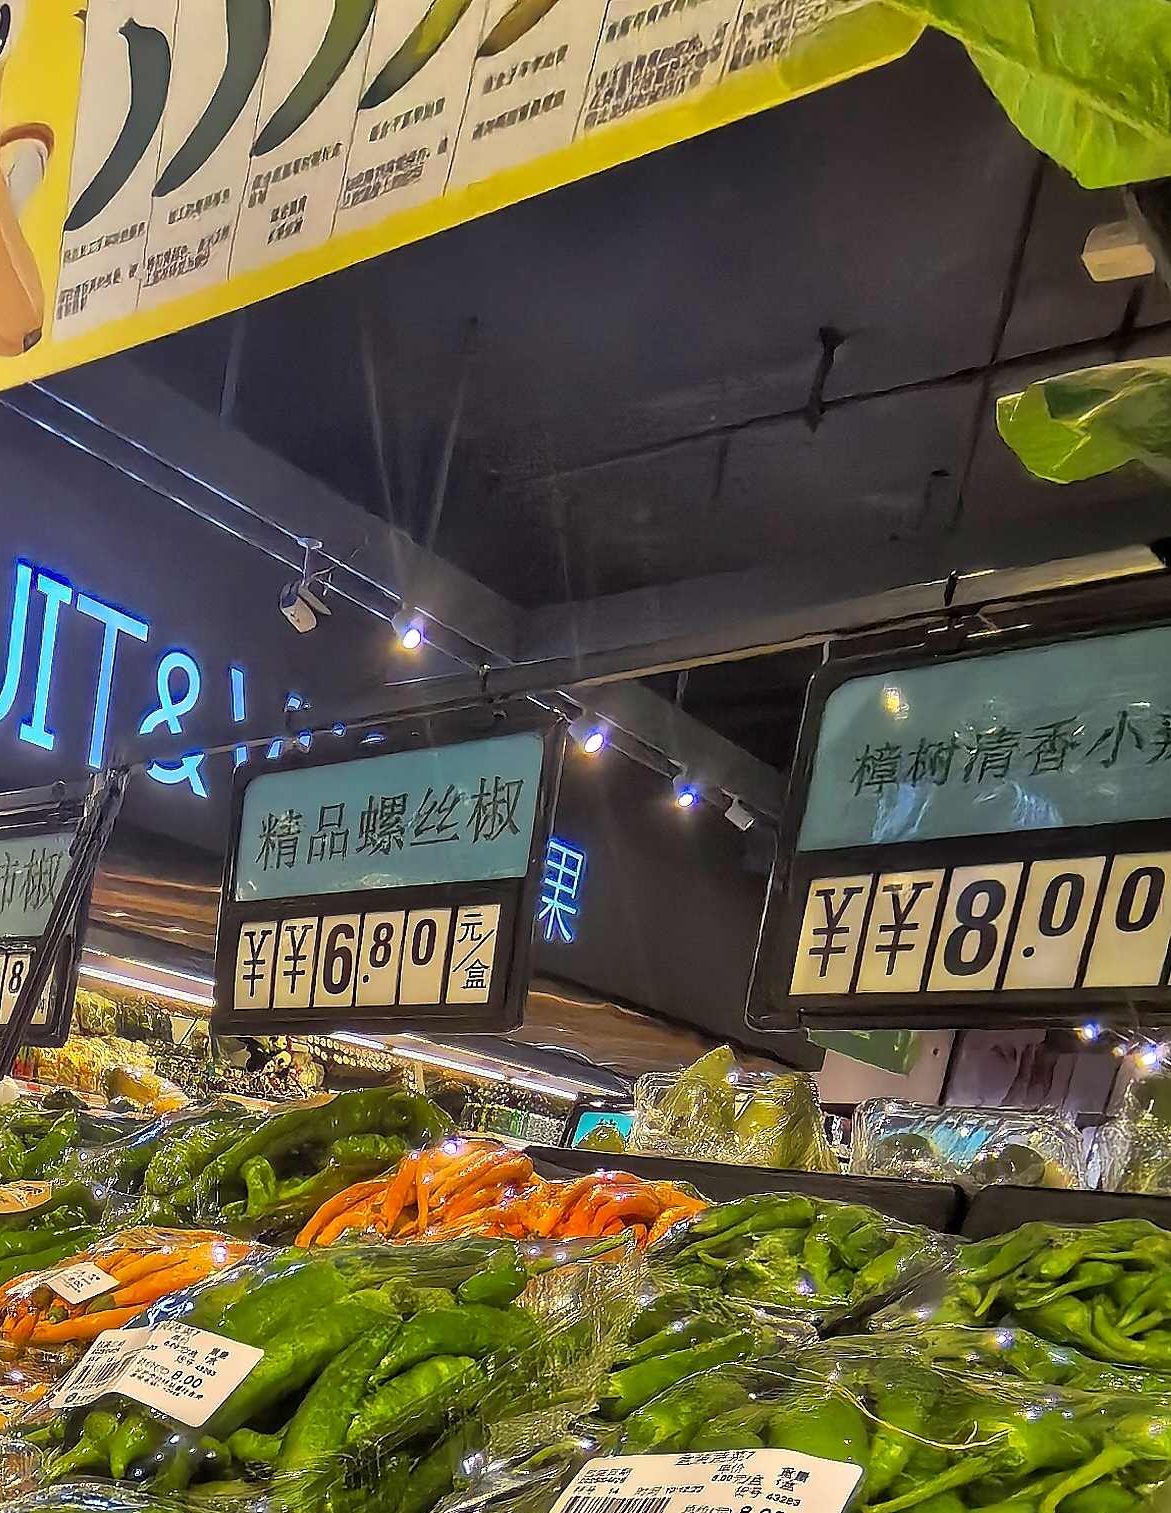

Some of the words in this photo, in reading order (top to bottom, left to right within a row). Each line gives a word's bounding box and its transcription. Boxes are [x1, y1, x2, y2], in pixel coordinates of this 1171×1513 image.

[139, 650, 209, 799] &
[256, 776, 525, 872] 精品螺丝椒
[539, 840, 585, 943] 果
[171, 1370, 203, 1389] 8.00
